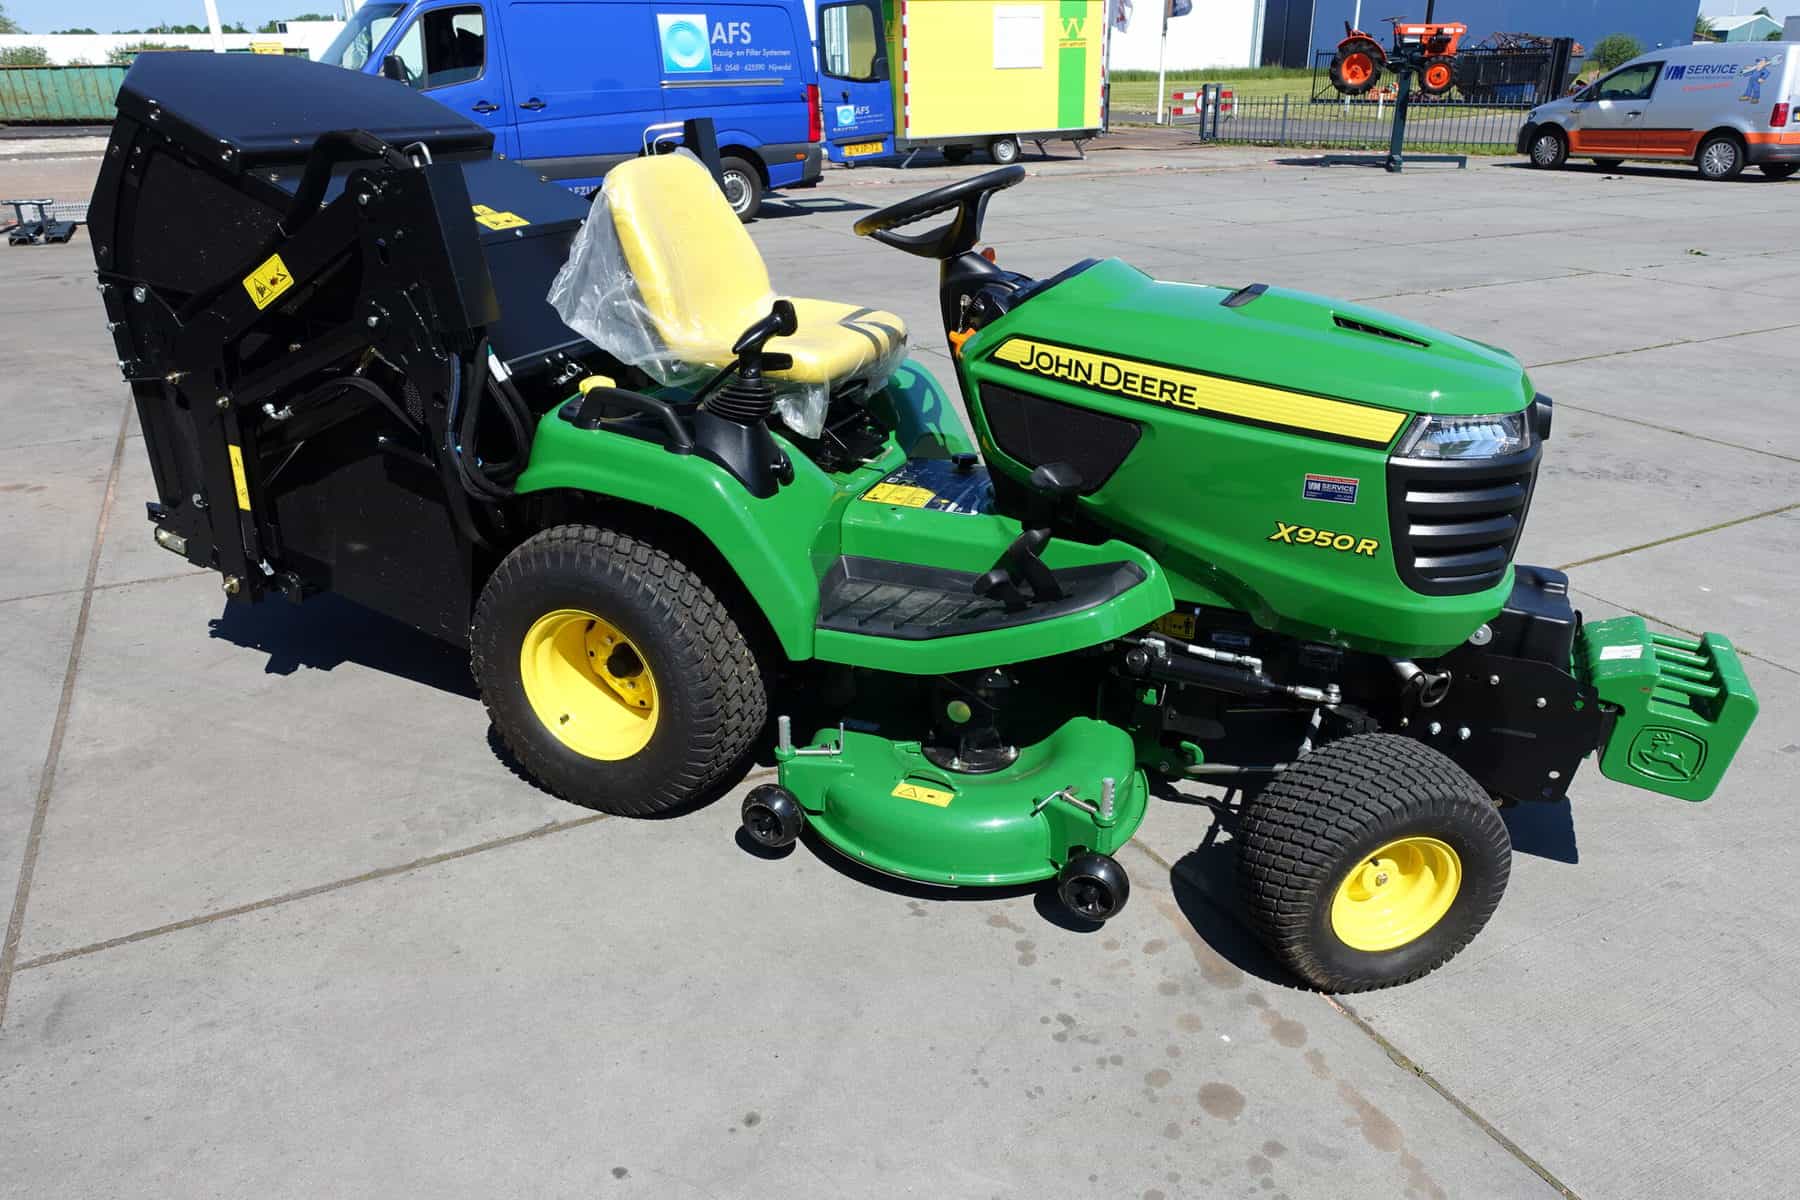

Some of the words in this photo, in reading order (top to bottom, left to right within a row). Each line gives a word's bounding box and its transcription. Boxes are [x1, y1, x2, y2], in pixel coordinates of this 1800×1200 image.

[711, 21, 752, 44] AFS
[1664, 65, 1686, 80] VM
[1687, 64, 1739, 74] SERVICE
[855, 105, 870, 114] AFS
[1019, 344, 1093, 382] JOHN
[1100, 361, 1198, 406] DEERE
[1321, 482, 1355, 494] SERVICE
[1268, 521, 1379, 557] X950R
